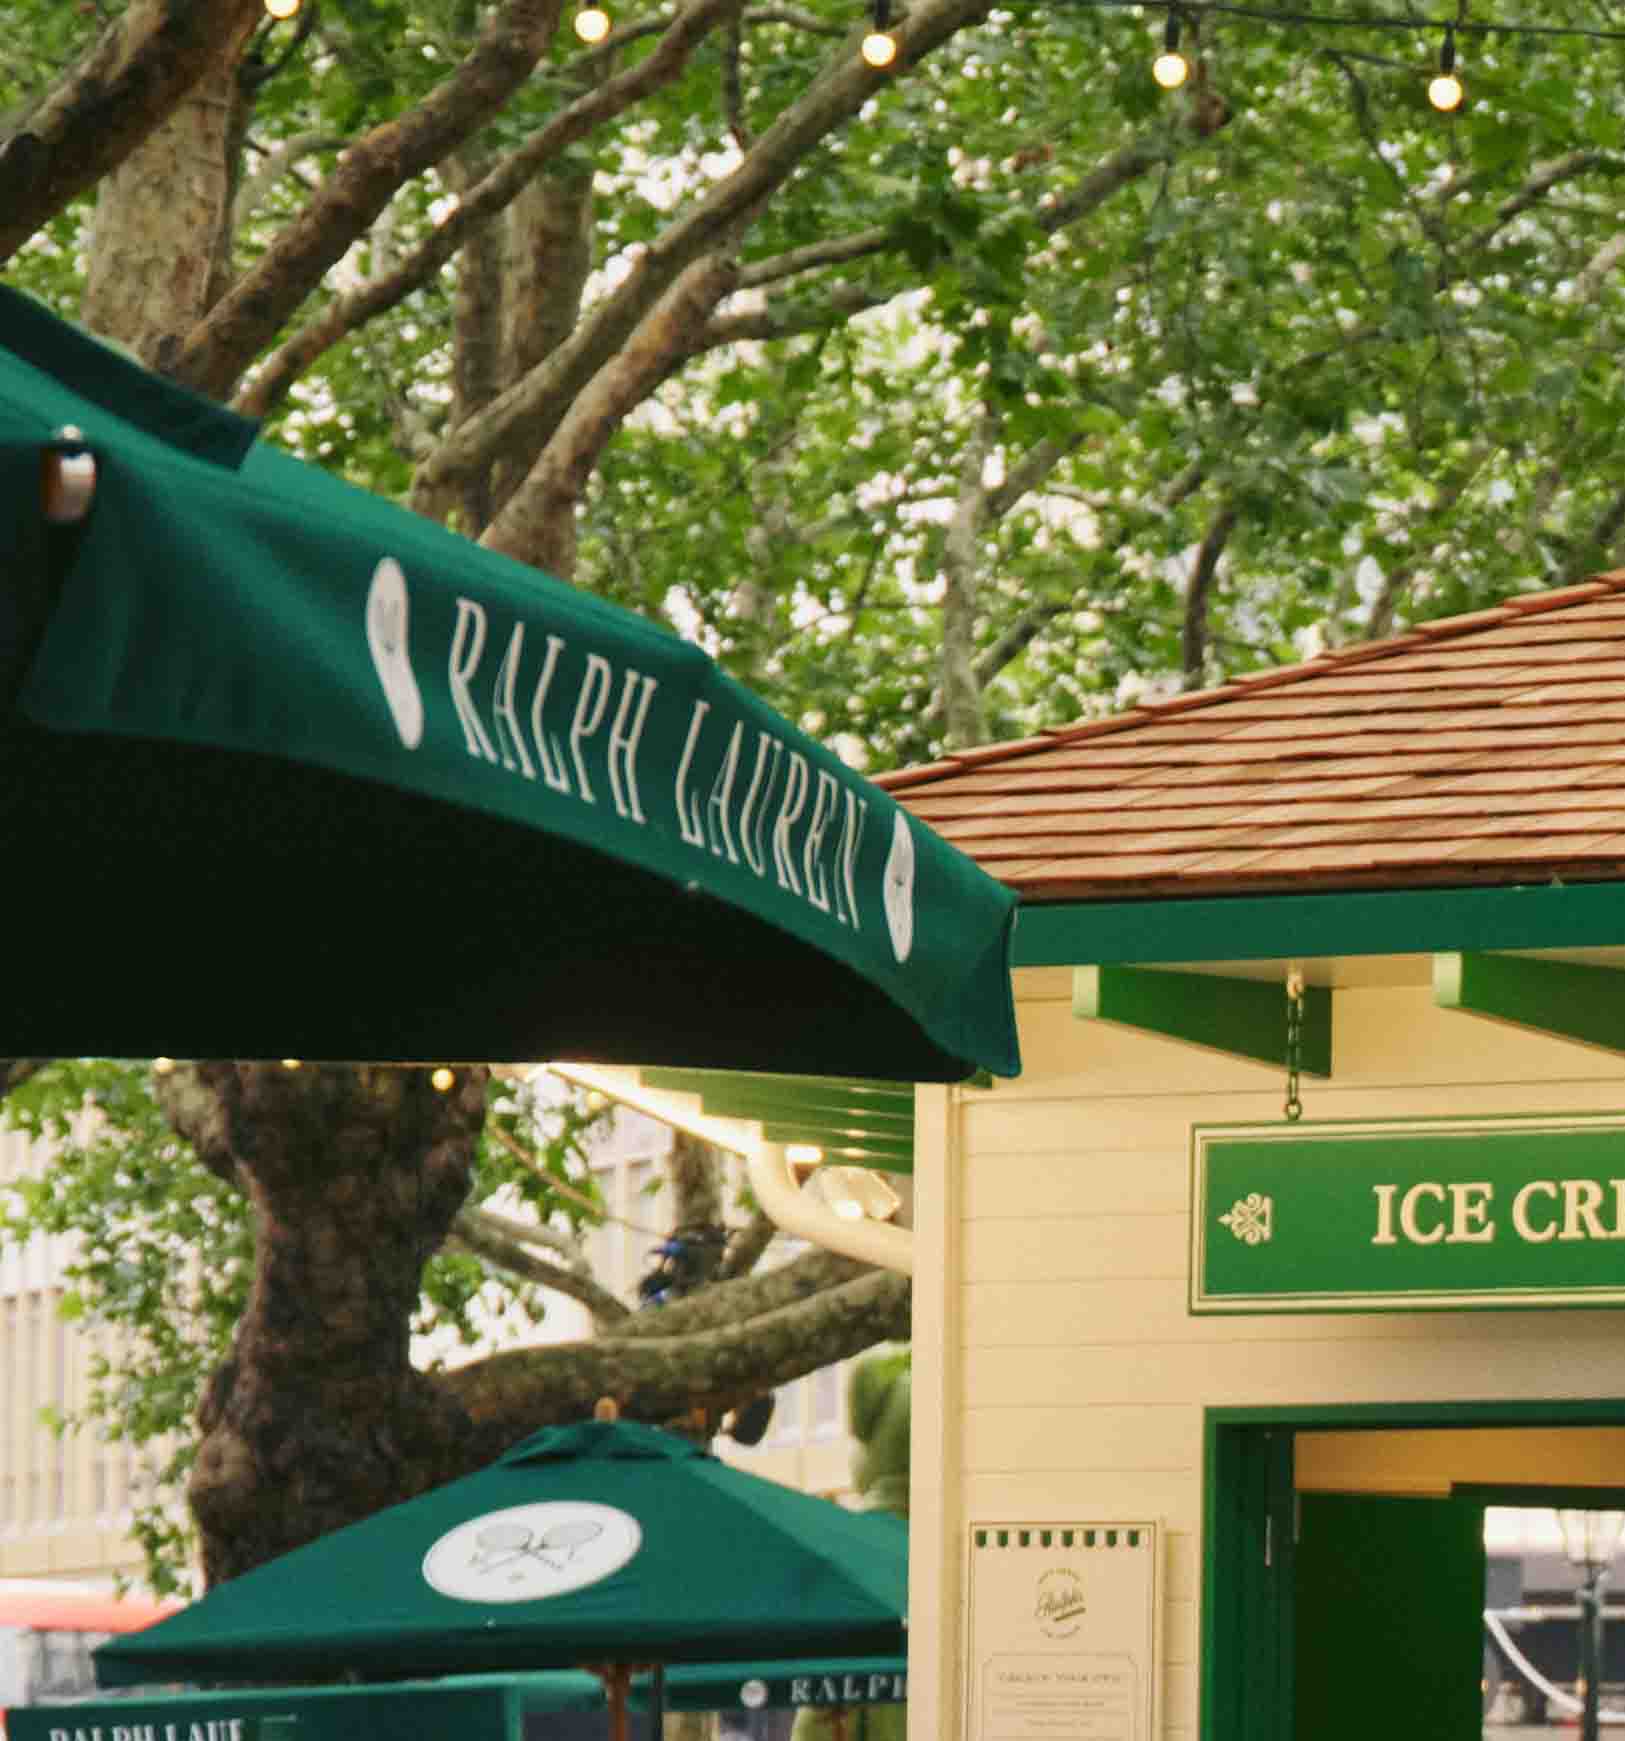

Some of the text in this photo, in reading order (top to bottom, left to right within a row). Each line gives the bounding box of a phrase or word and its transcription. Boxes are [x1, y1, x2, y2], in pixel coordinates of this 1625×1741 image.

[449, 597, 868, 931] RALPH LAUREN
[1372, 1182, 1494, 1245] ICE
